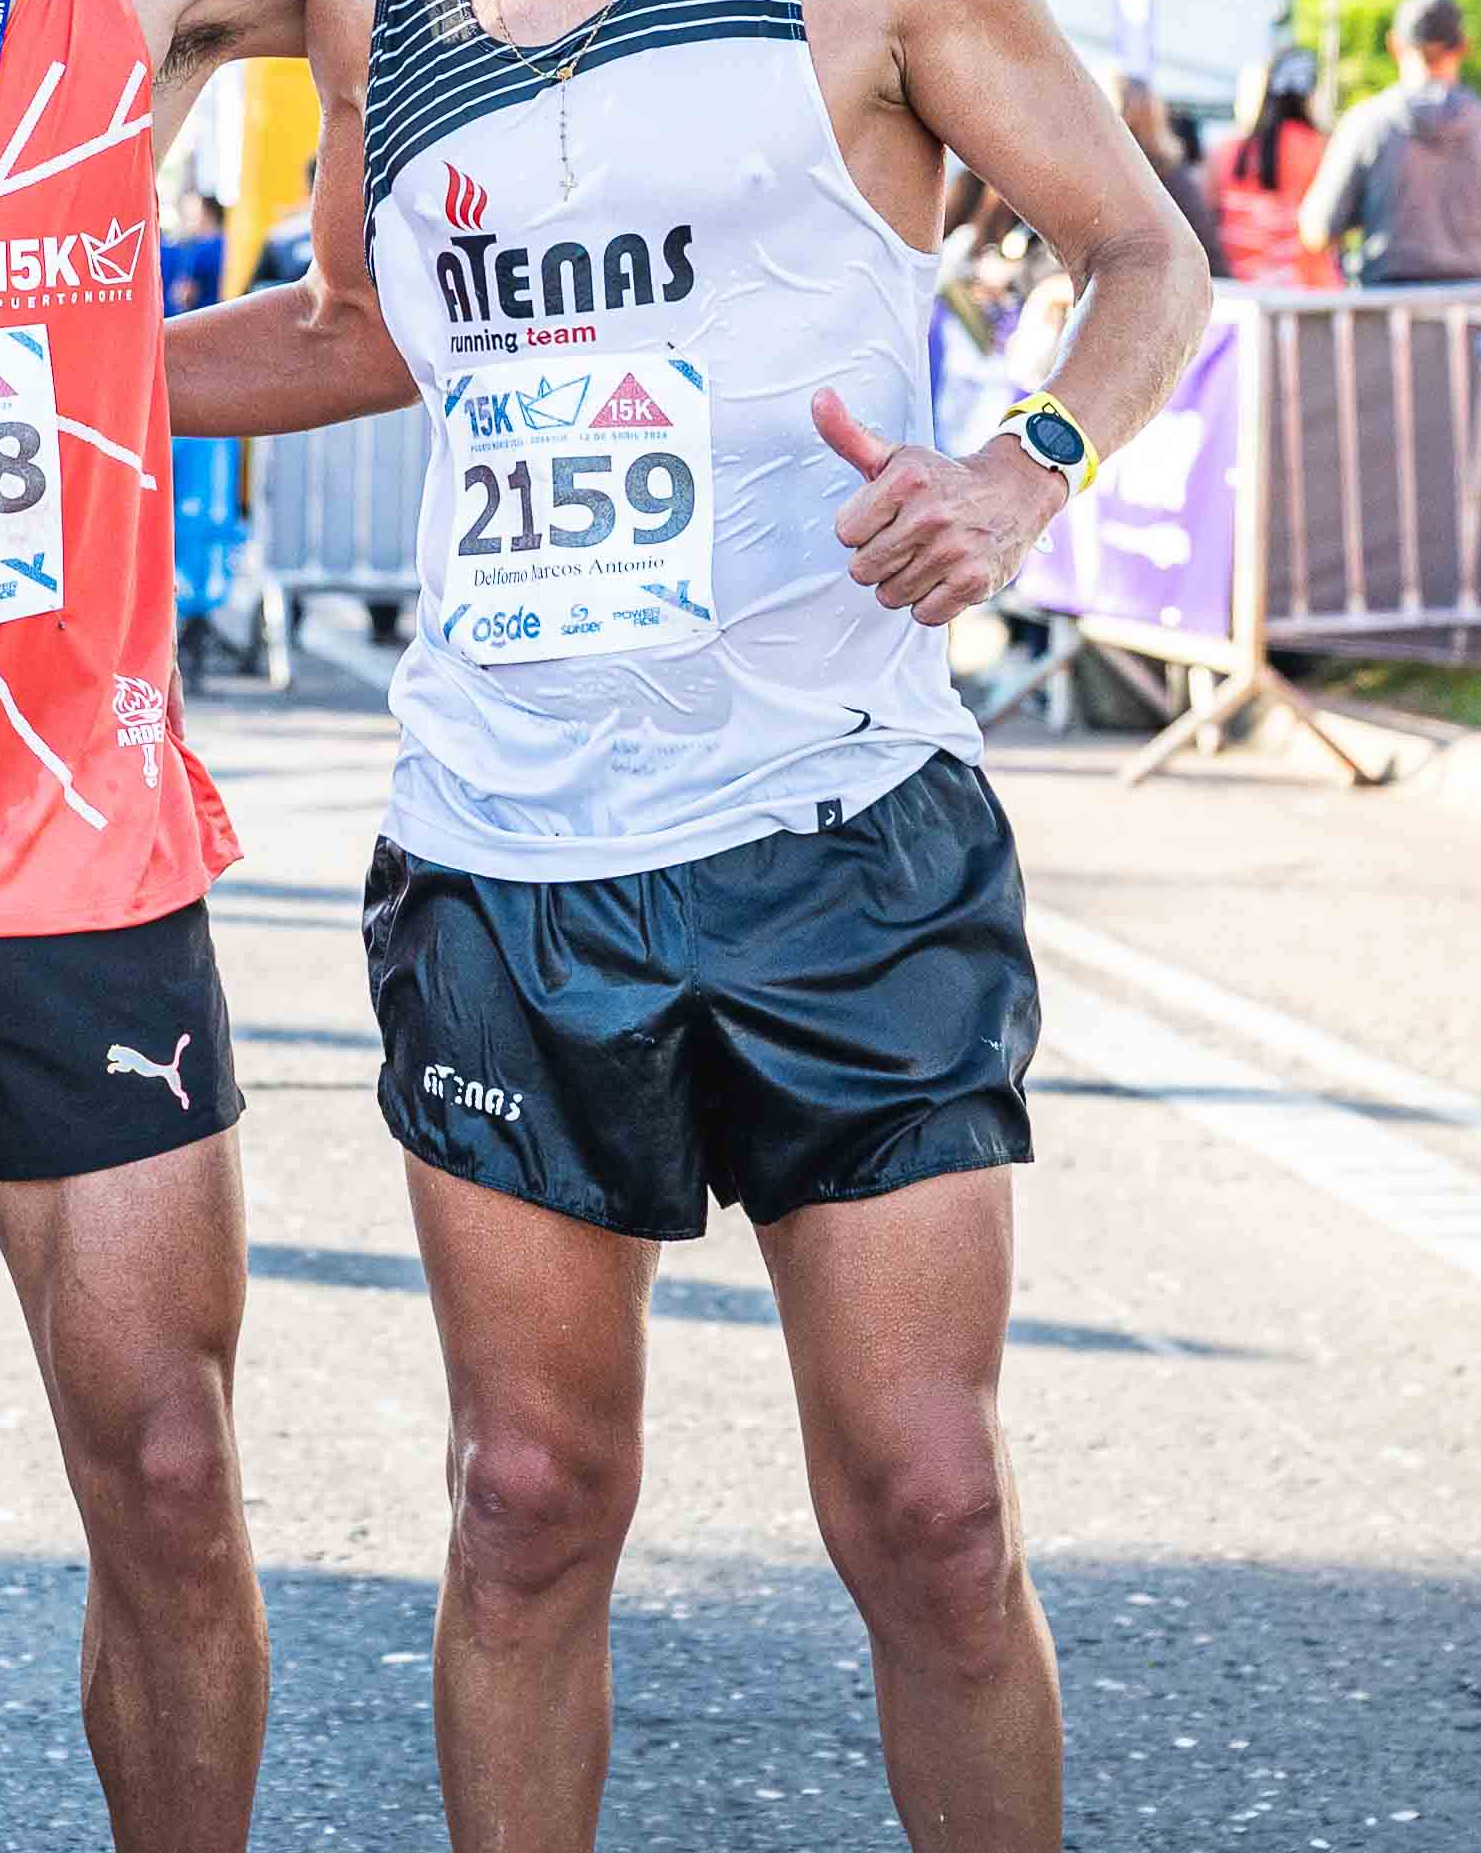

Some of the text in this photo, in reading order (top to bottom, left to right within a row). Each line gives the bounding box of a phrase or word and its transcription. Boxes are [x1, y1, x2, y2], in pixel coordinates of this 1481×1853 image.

[436, 223, 696, 324] ATENAS
[449, 324, 597, 355] running team
[464, 392, 514, 438] 15K
[608, 398, 654, 422] 15K
[458, 451, 697, 556] 2159
[588, 555, 665, 575] Antonio
[472, 604, 541, 647] osde
[117, 721, 165, 748] ARDE
